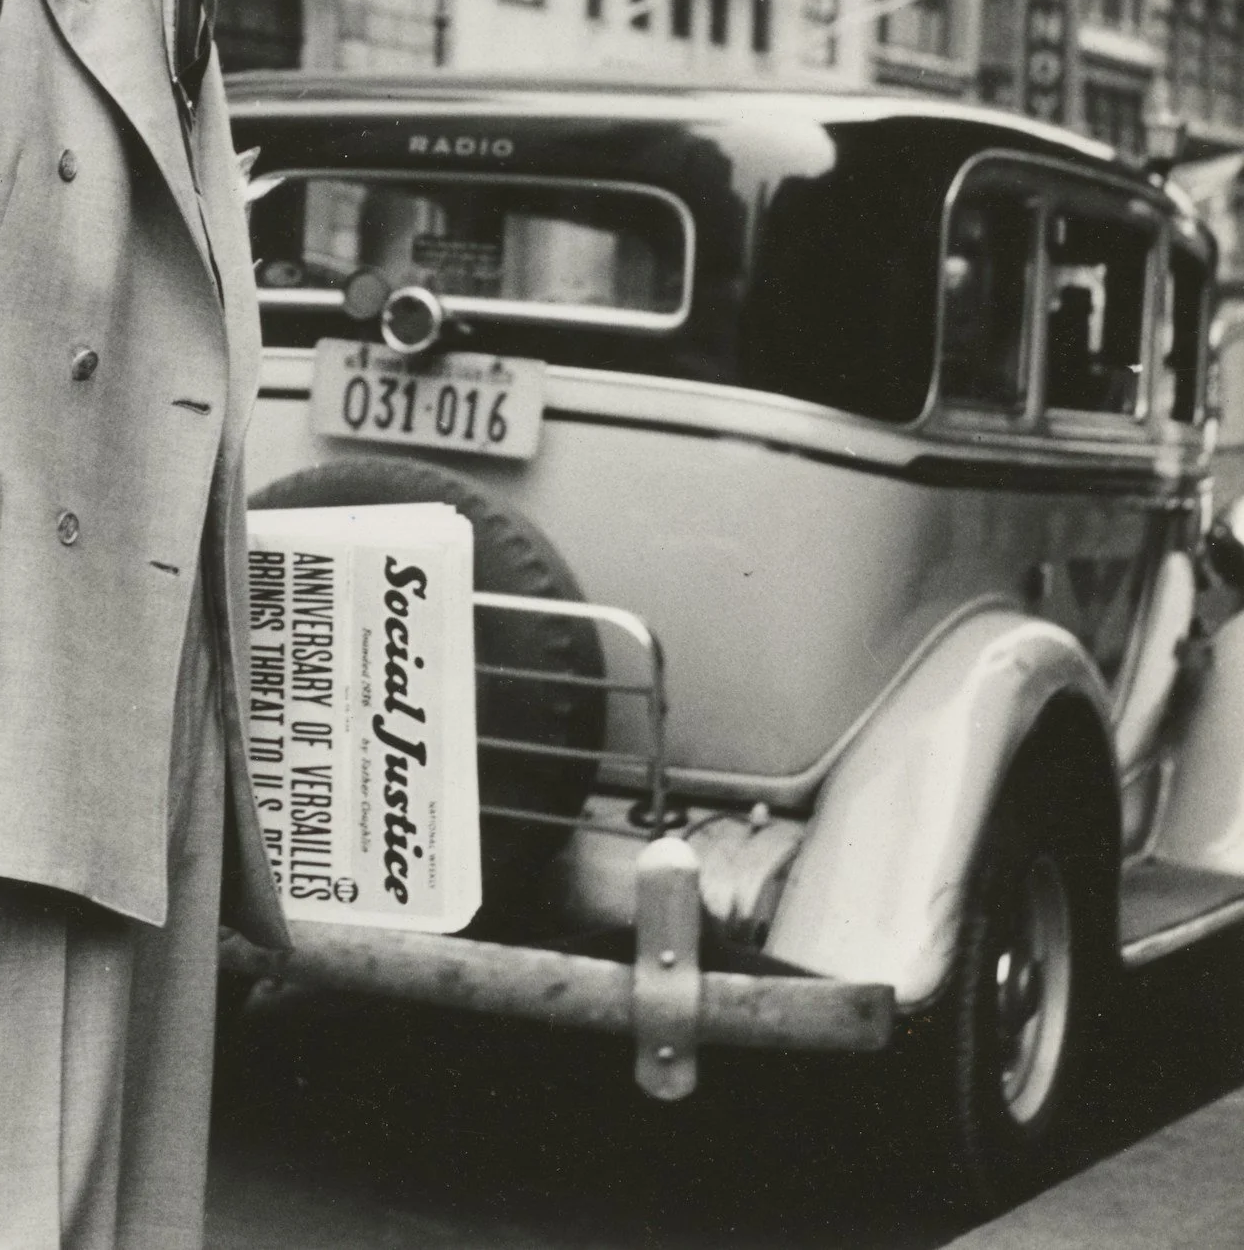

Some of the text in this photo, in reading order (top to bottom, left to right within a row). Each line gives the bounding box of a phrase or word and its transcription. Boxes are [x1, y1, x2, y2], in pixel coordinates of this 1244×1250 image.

[409, 135, 514, 158] RADIO
[248, 550, 286, 632] BRINGS
[361, 627, 372, 678] Founded
[249, 642, 285, 726] THREAT
[249, 736, 284, 763] TO
[290, 551, 334, 902] ANNIVERSARY OF VERSAILLES
[359, 738, 371, 753] by
[372, 554, 428, 906] Social Justice
[360, 756, 372, 798] Father
[359, 800, 372, 854] Coughlin
